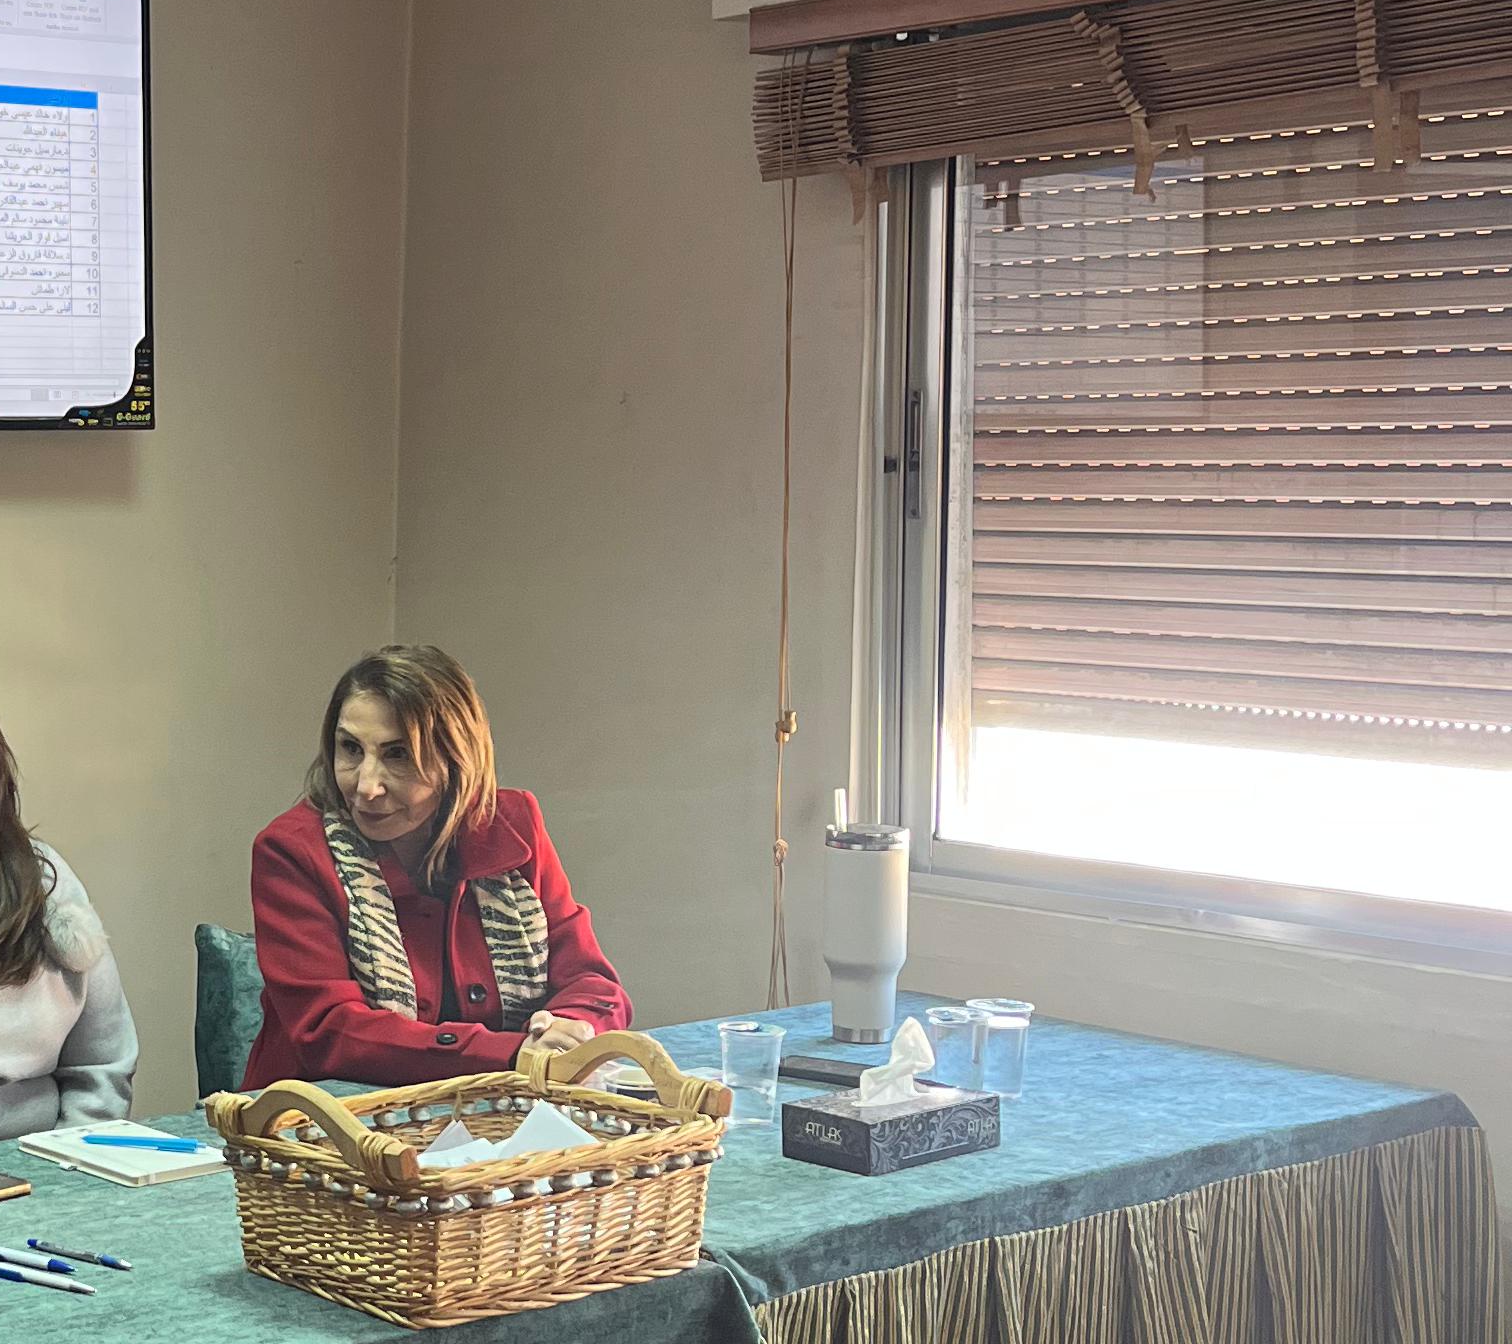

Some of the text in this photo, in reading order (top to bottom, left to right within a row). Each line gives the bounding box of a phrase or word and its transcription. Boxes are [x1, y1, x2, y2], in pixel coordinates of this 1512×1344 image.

[90, 112, 95, 122] 1
[90, 130, 96, 141] 2
[90, 147, 96, 158] 3
[90, 165, 96, 175] 4
[90, 182, 97, 193] 5
[90, 199, 97, 210] 6
[91, 217, 97, 227] 7
[87, 268, 98, 279] 10
[87, 286, 98, 296] 11
[87, 303, 98, 314] 12
[805, 1121, 842, 1141] ATLAS
